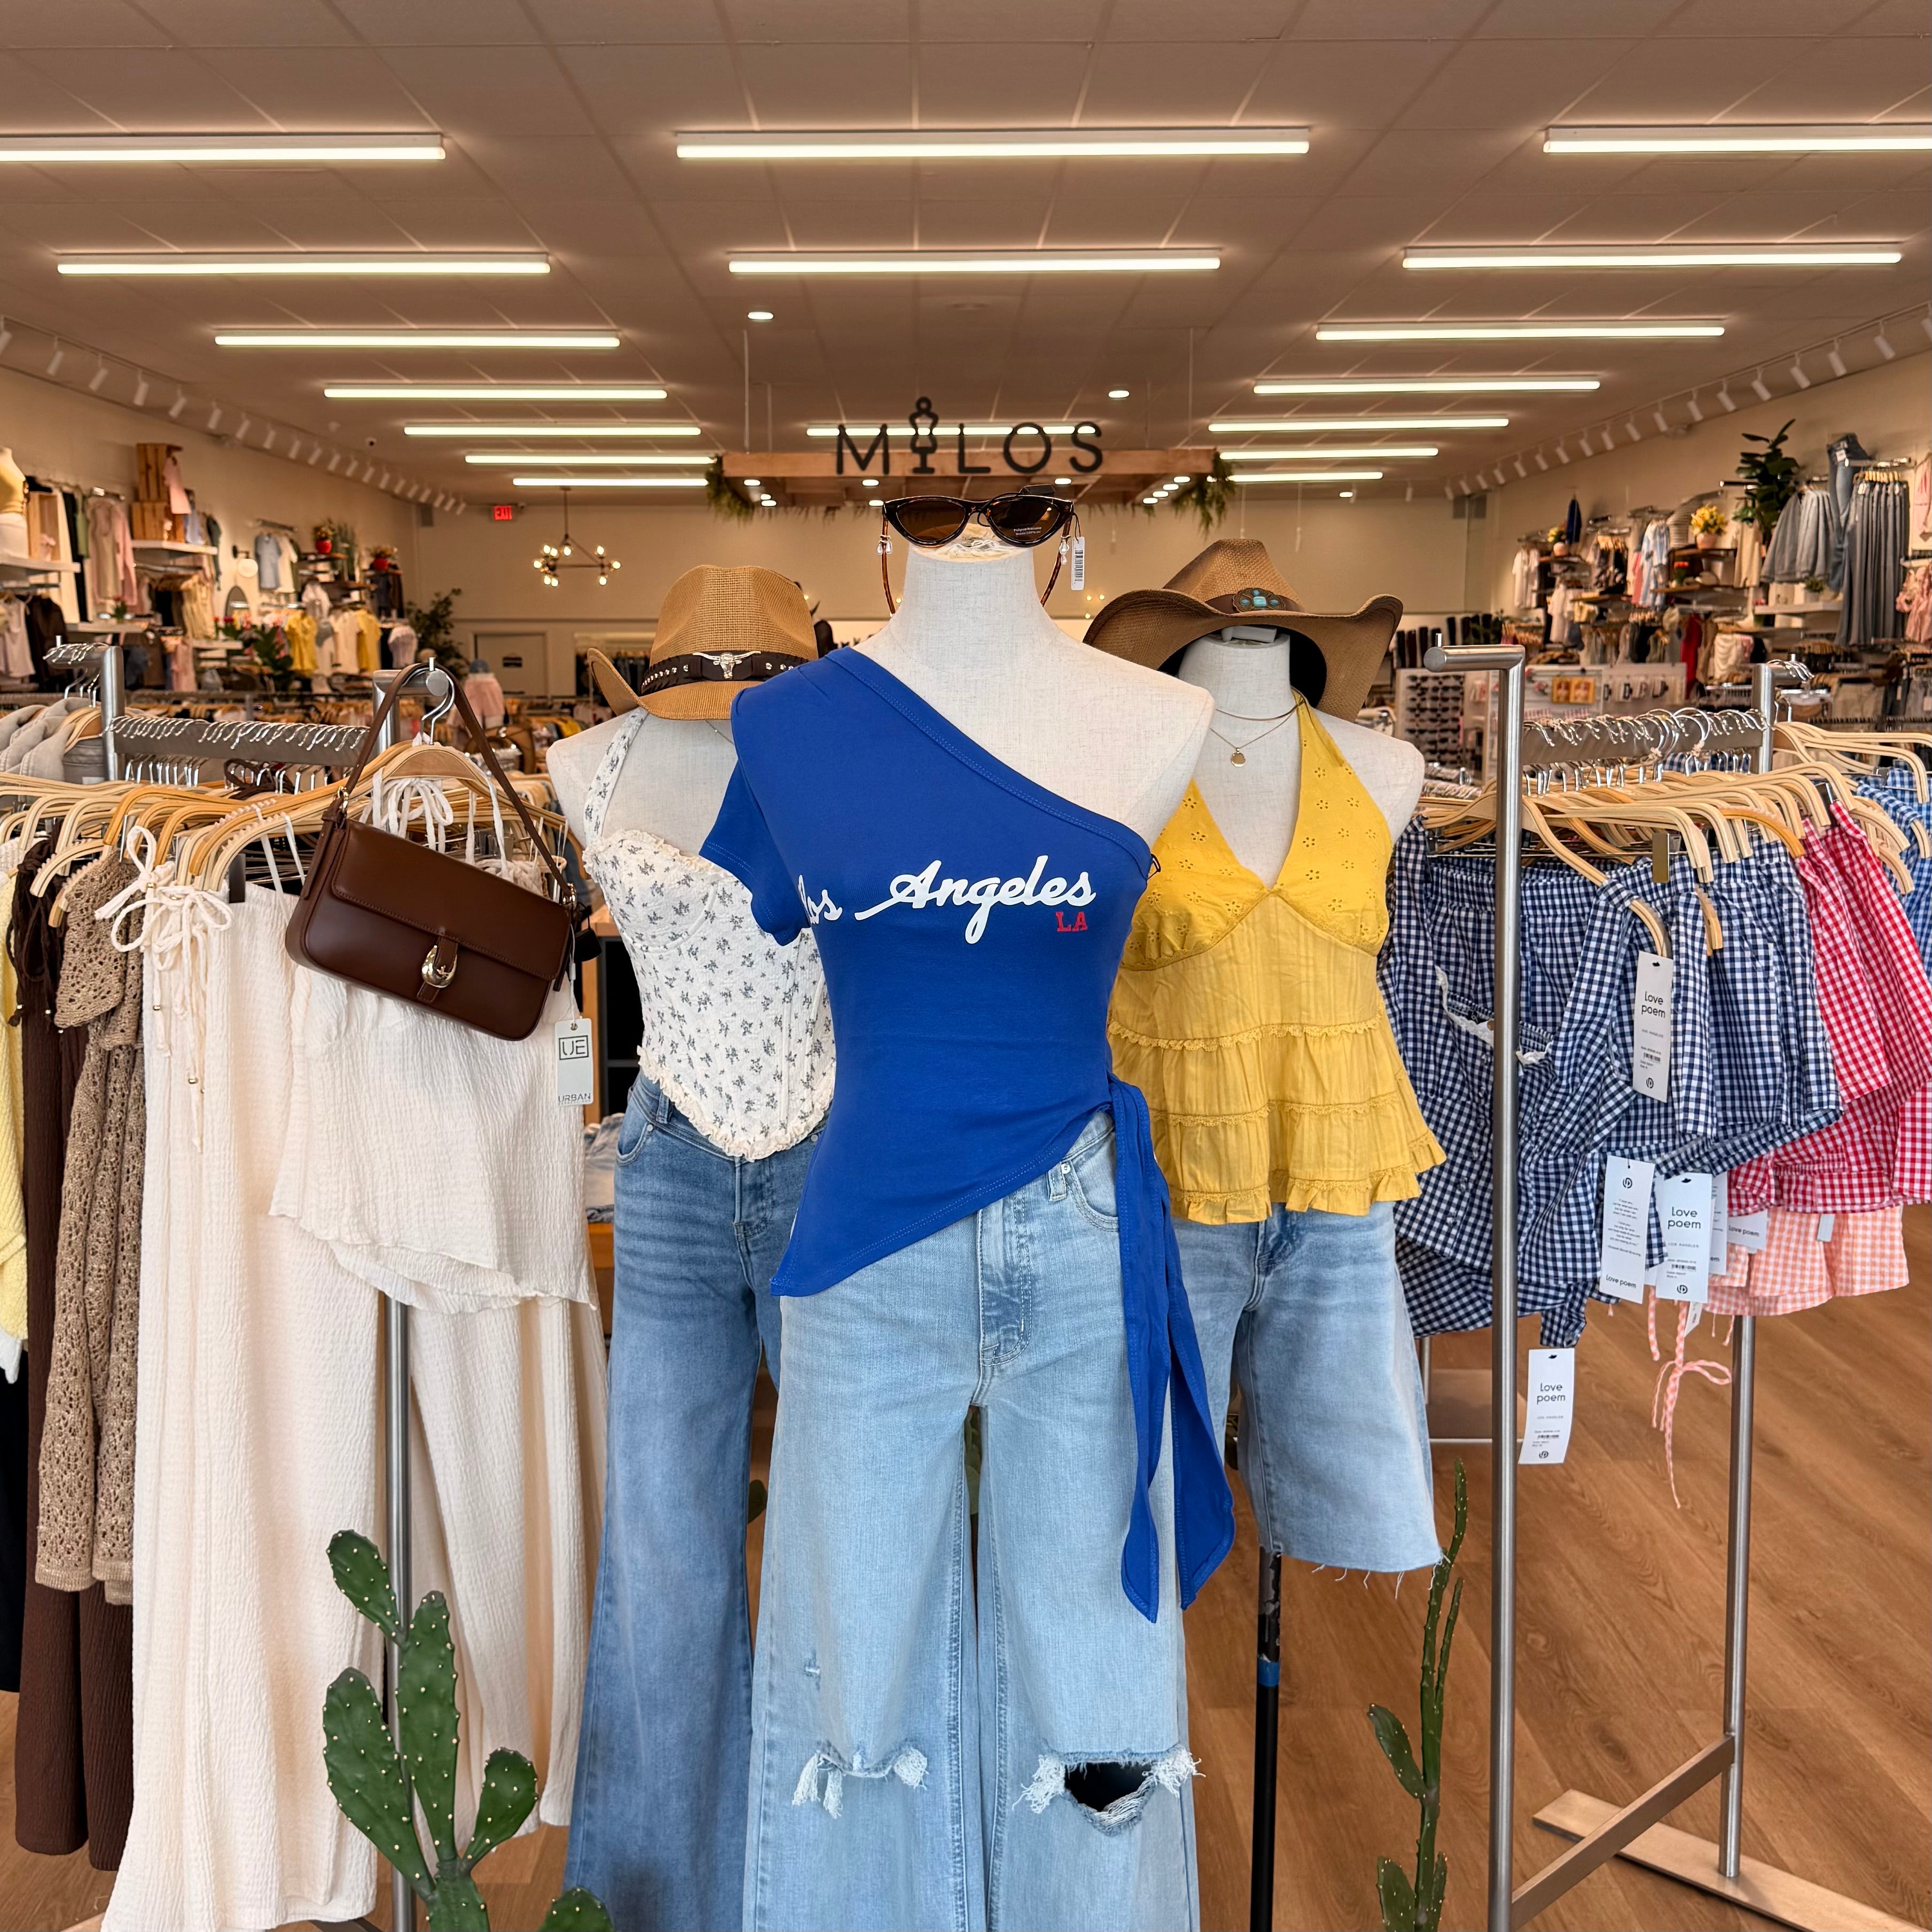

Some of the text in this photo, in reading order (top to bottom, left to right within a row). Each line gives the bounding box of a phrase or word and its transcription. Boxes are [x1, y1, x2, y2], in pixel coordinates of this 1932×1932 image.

[855, 856, 1096, 944] Angeles
[1055, 911, 1088, 932] LA
[1641, 1004, 1665, 1018] poem
[562, 1039, 585, 1055] UE
[558, 1093, 591, 1102] URBAN
[1671, 1207, 1698, 1217] Love
[1668, 1220, 1701, 1230] poem
[1620, 1279, 1636, 1289] poem
[1540, 1383, 1563, 1392] Love
[1537, 1394, 1566, 1404] poem
